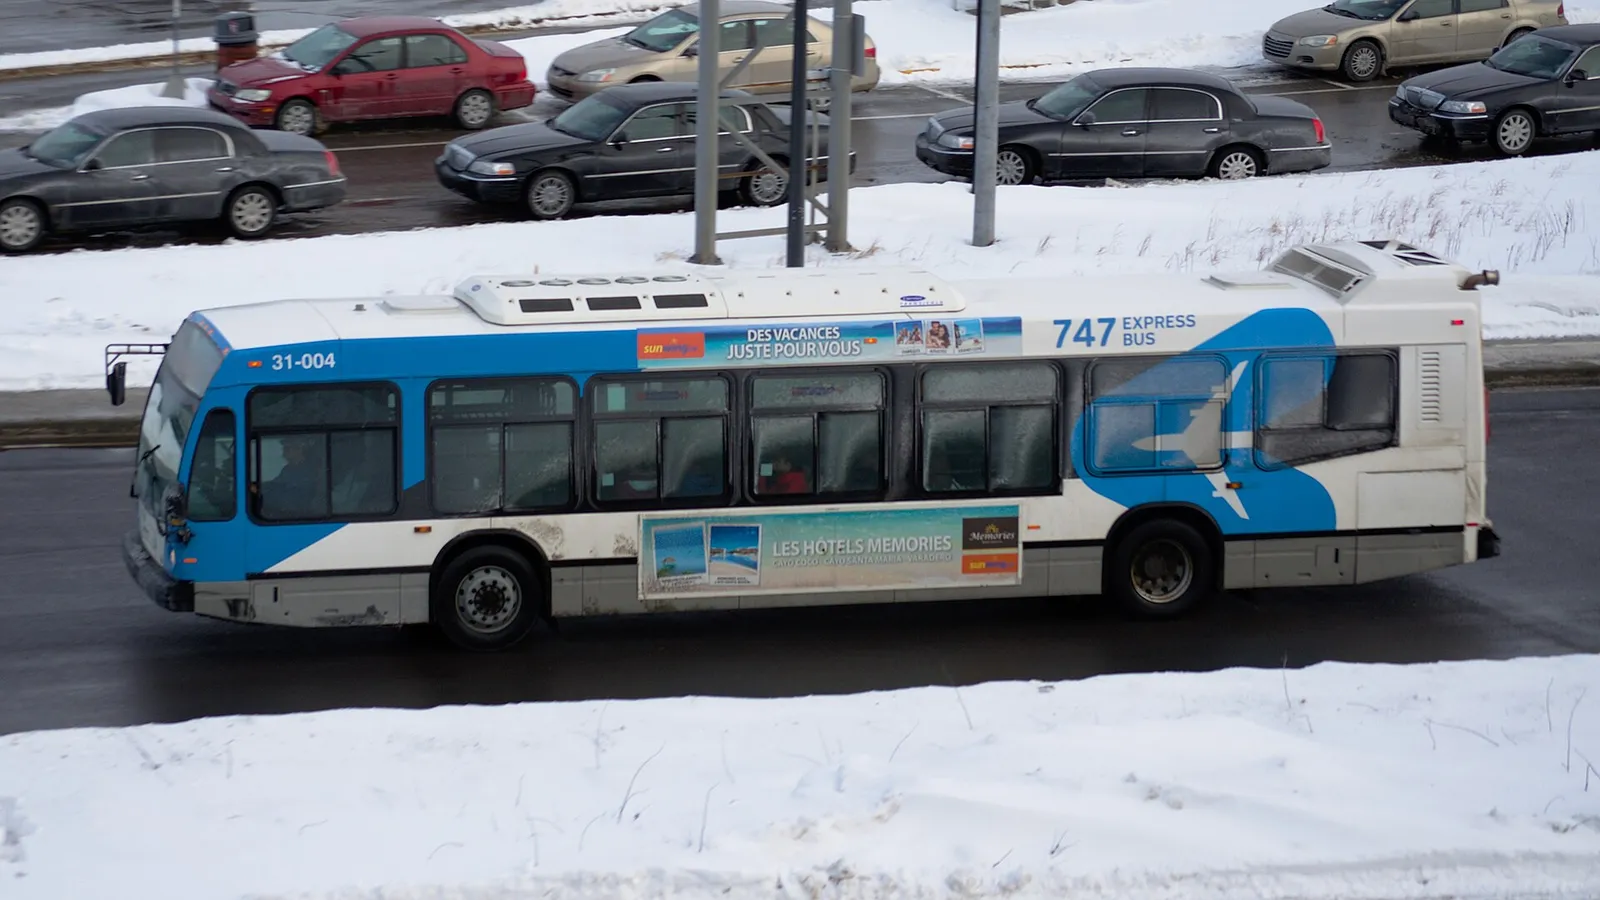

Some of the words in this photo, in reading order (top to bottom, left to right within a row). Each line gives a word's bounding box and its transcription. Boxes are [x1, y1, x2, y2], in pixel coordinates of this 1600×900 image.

[1122, 314, 1196, 330] EXPRESS
[747, 328, 771, 342] DES
[773, 326, 841, 341] VACANCES
[1053, 317, 1117, 349] 747
[1123, 332, 1156, 347] BUS
[727, 342, 772, 360] JUSTE
[774, 341, 817, 358] POUR
[817, 340, 861, 356] VOUS
[271, 352, 337, 371] 31-004
[969, 531, 1016, 542] Memories
[772, 540, 800, 557] LES
[803, 536, 864, 556] HÔTELS
[867, 535, 952, 554] MEMORIES
